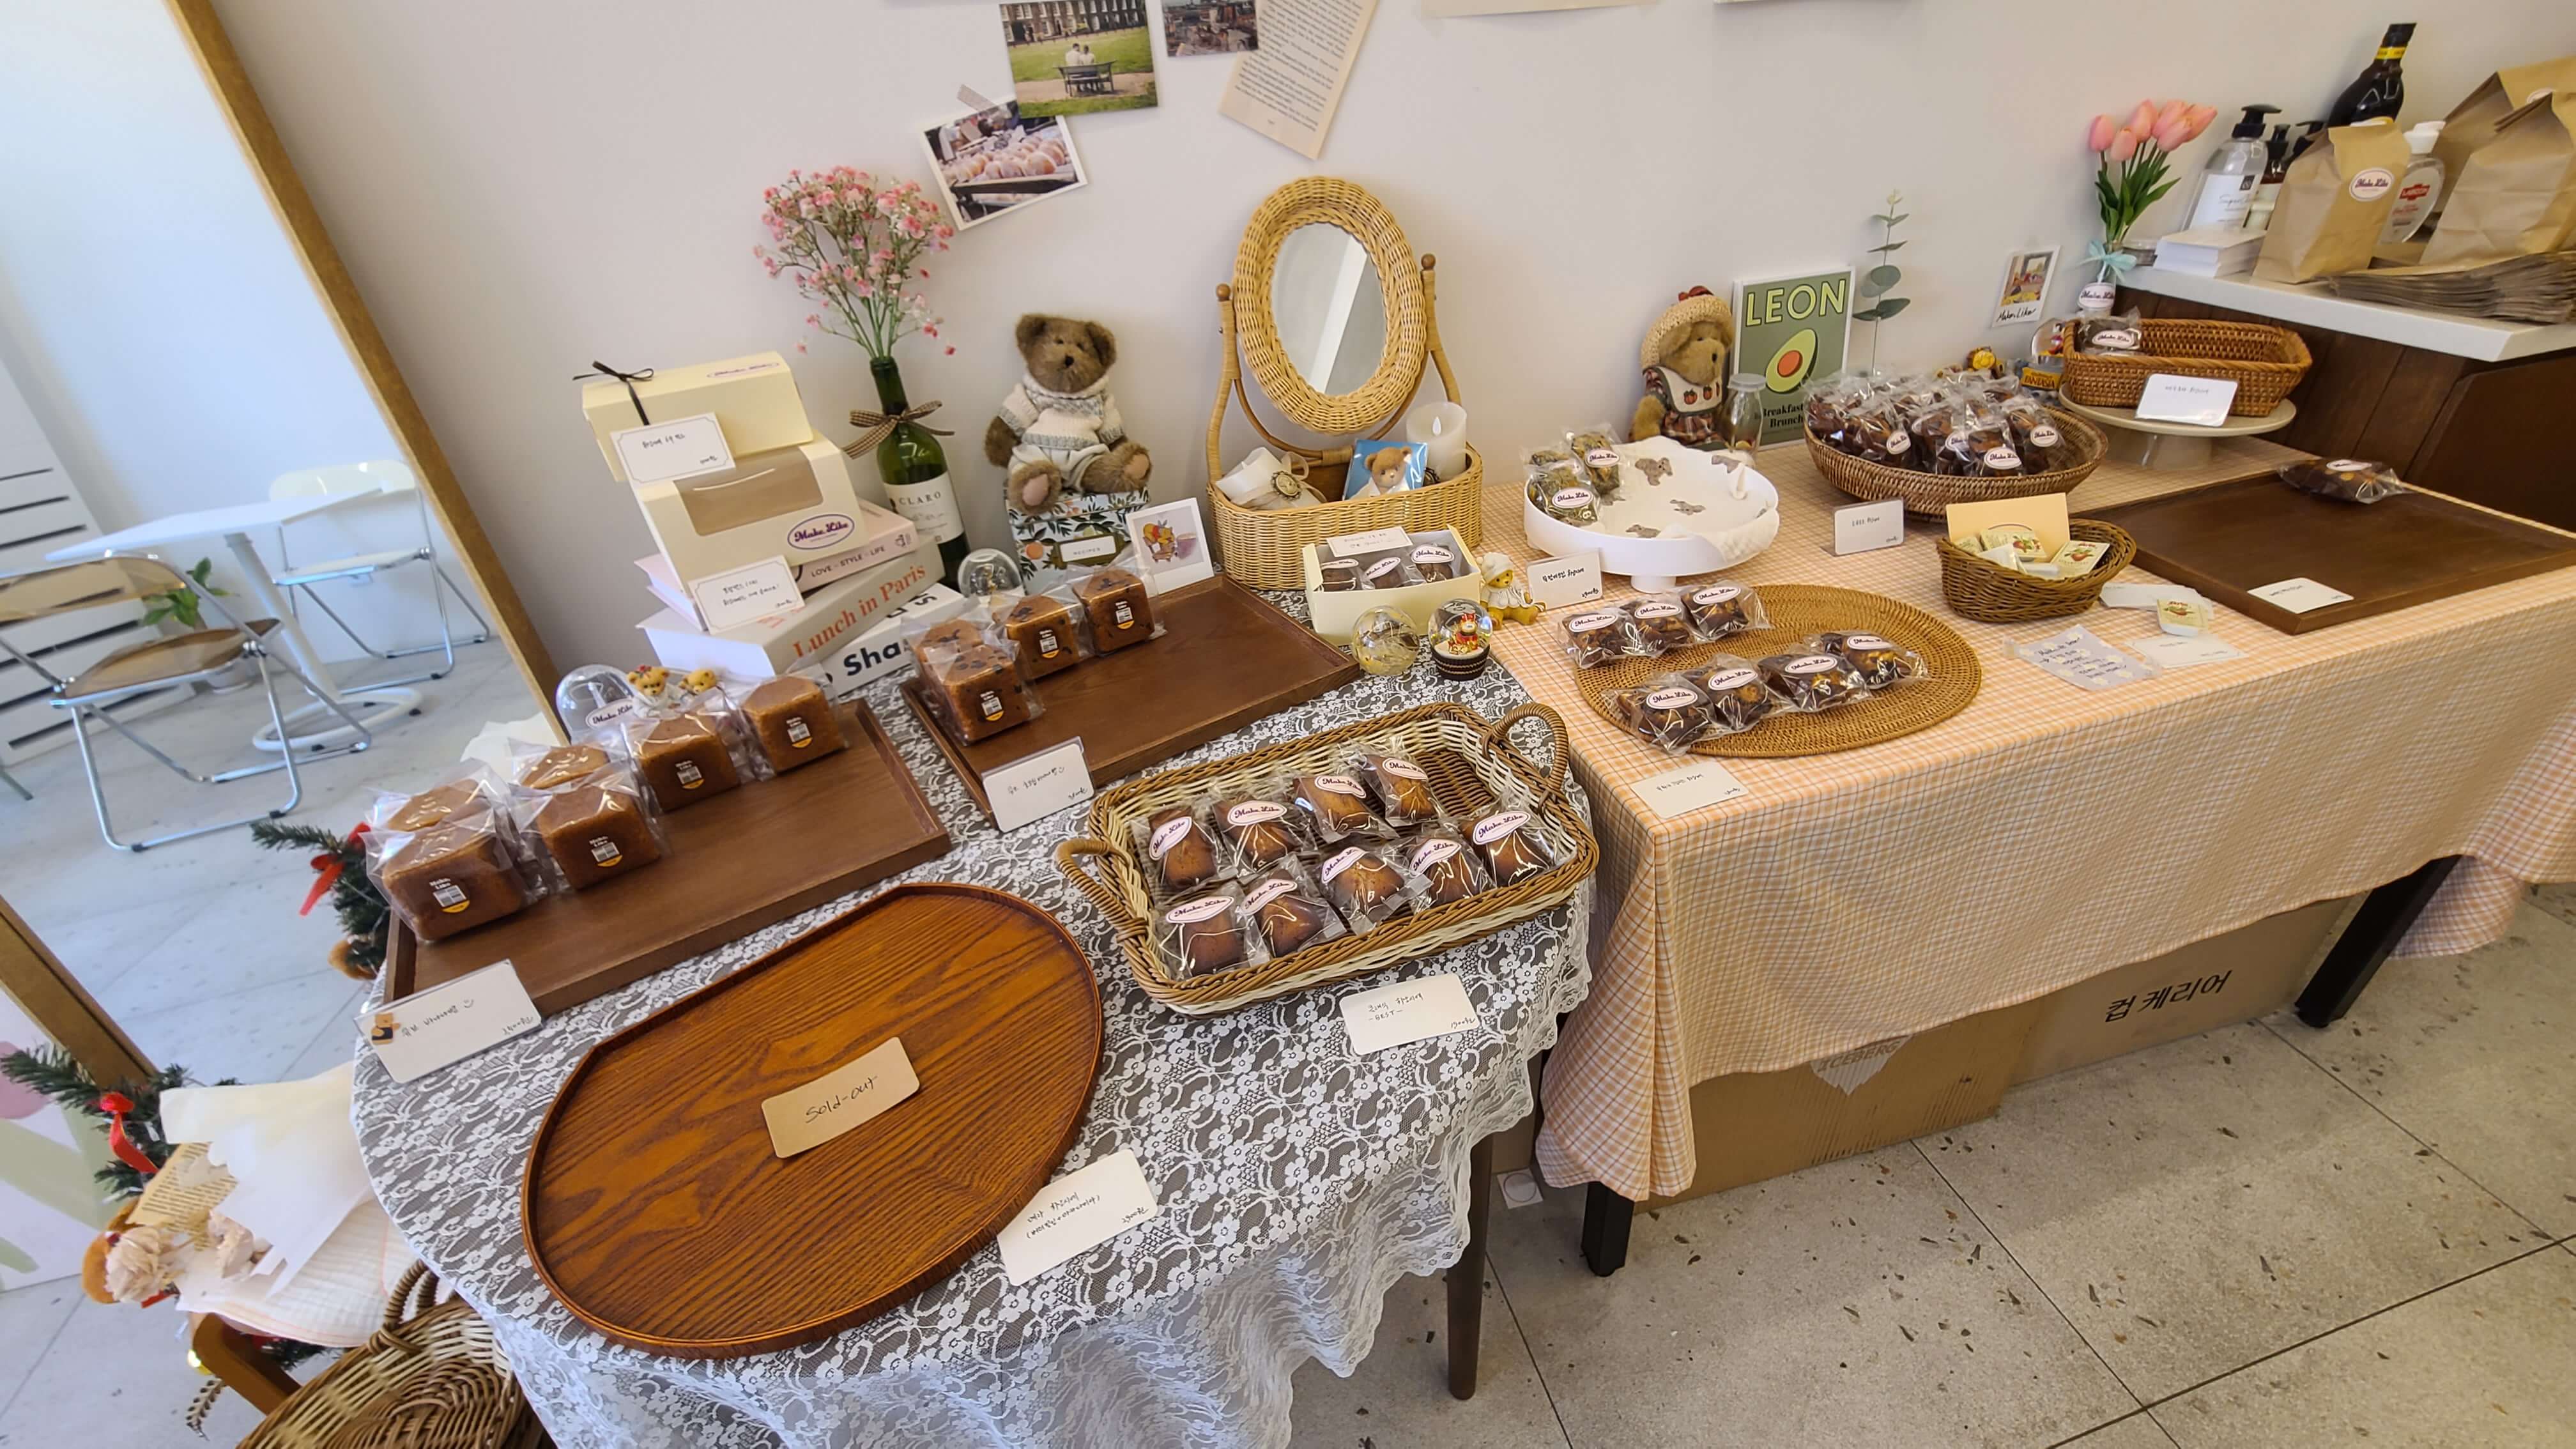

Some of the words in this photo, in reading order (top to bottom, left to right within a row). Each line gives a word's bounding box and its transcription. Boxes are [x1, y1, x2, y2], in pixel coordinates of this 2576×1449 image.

[2355, 179, 2374, 188] Make
[2375, 179, 2388, 187] Like
[1745, 279, 1846, 327] LEON
[1761, 403, 1804, 418] Breakfast
[1770, 415, 1804, 428] Brunch
[899, 491, 942, 505] CLARO
[794, 527, 824, 542] Make
[826, 521, 849, 533] Like
[811, 565, 832, 578] LOVE
[840, 553, 863, 567] STYLE
[870, 546, 886, 556] LIFE
[1699, 592, 1718, 601] Make
[792, 608, 858, 658] Lunch
[858, 595, 879, 617] in
[878, 565, 926, 603] Paris
[1574, 618, 1595, 627] Make
[1791, 662, 1813, 671] Make
[1813, 658, 1831, 666] Like
[1714, 675, 1735, 686] Make
[1735, 670, 1753, 679] Like
[1652, 693, 1673, 703] Make
[1674, 691, 1692, 699] Like
[1322, 777, 1347, 787] Make
[1234, 807, 1260, 818] Make
[1261, 805, 1280, 814] Like
[1478, 822, 1503, 838] Make
[1503, 815, 1523, 824] Like
[1152, 832, 1169, 852] Make
[1168, 820, 1186, 835] Like
[1413, 850, 1433, 871] Make
[1433, 841, 1455, 851] Like
[1324, 859, 1346, 876] Make
[1174, 905, 1203, 917] Make
[1204, 899, 1227, 908] Like
[1245, 891, 1268, 909] Make
[2104, 995, 2137, 1023] 컵
[2137, 969, 2234, 1013] 케리어
[1816, 1040, 1902, 1073] ICEBERG
